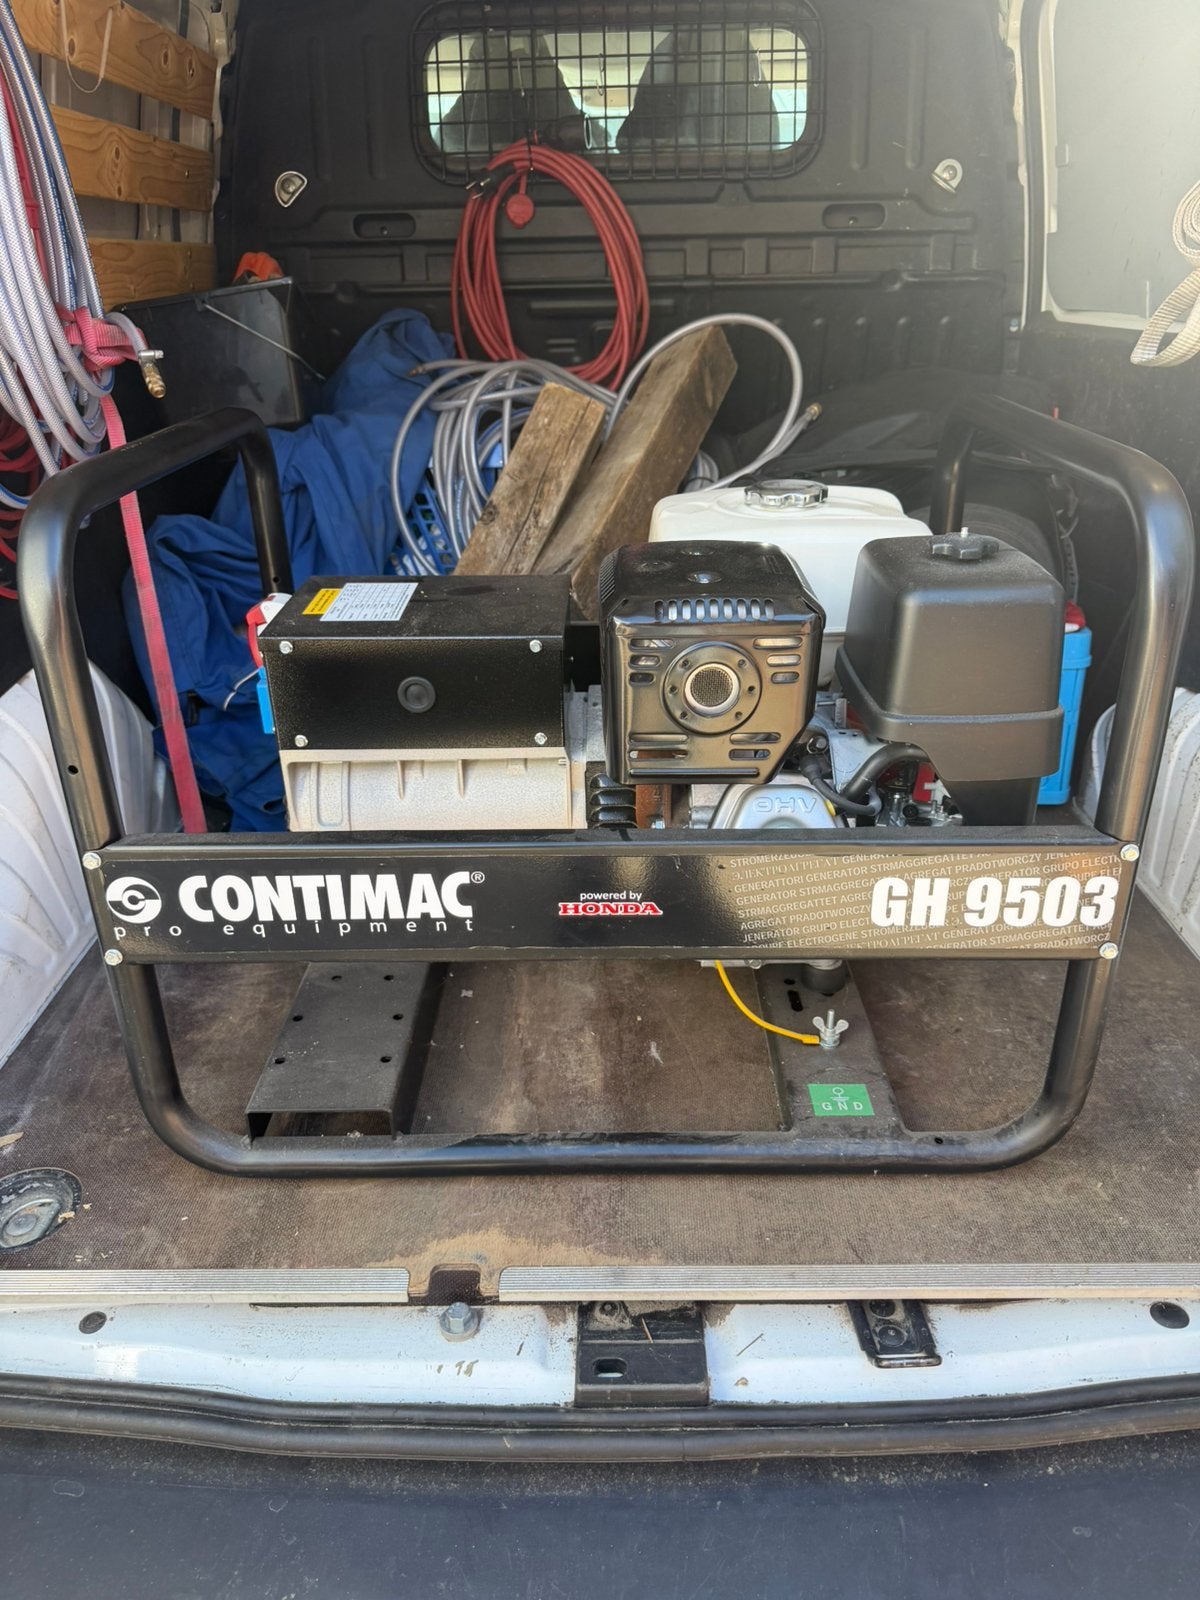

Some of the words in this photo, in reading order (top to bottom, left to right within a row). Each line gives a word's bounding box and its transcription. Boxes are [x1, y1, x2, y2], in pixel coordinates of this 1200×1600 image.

[734, 874, 803, 893] GENERATTORI
[805, 865, 867, 883] GENERATOR
[580, 890, 626, 901] powered
[629, 890, 642, 901] by
[736, 889, 796, 905] GENERATOR
[738, 896, 836, 918] STRMAGGREGATTET
[1043, 860, 1078, 874] GRUPO
[558, 901, 663, 916] HONDA
[871, 877, 950, 927] GH
[963, 876, 1119, 927] 9503
[113, 925, 182, 941] pro
[223, 917, 473, 939] equipment
[740, 916, 786, 930] AGREGAT
[742, 926, 799, 943] JENERATOR
[802, 921, 836, 934] GRUPO
[821, 1101, 863, 1111] GND
